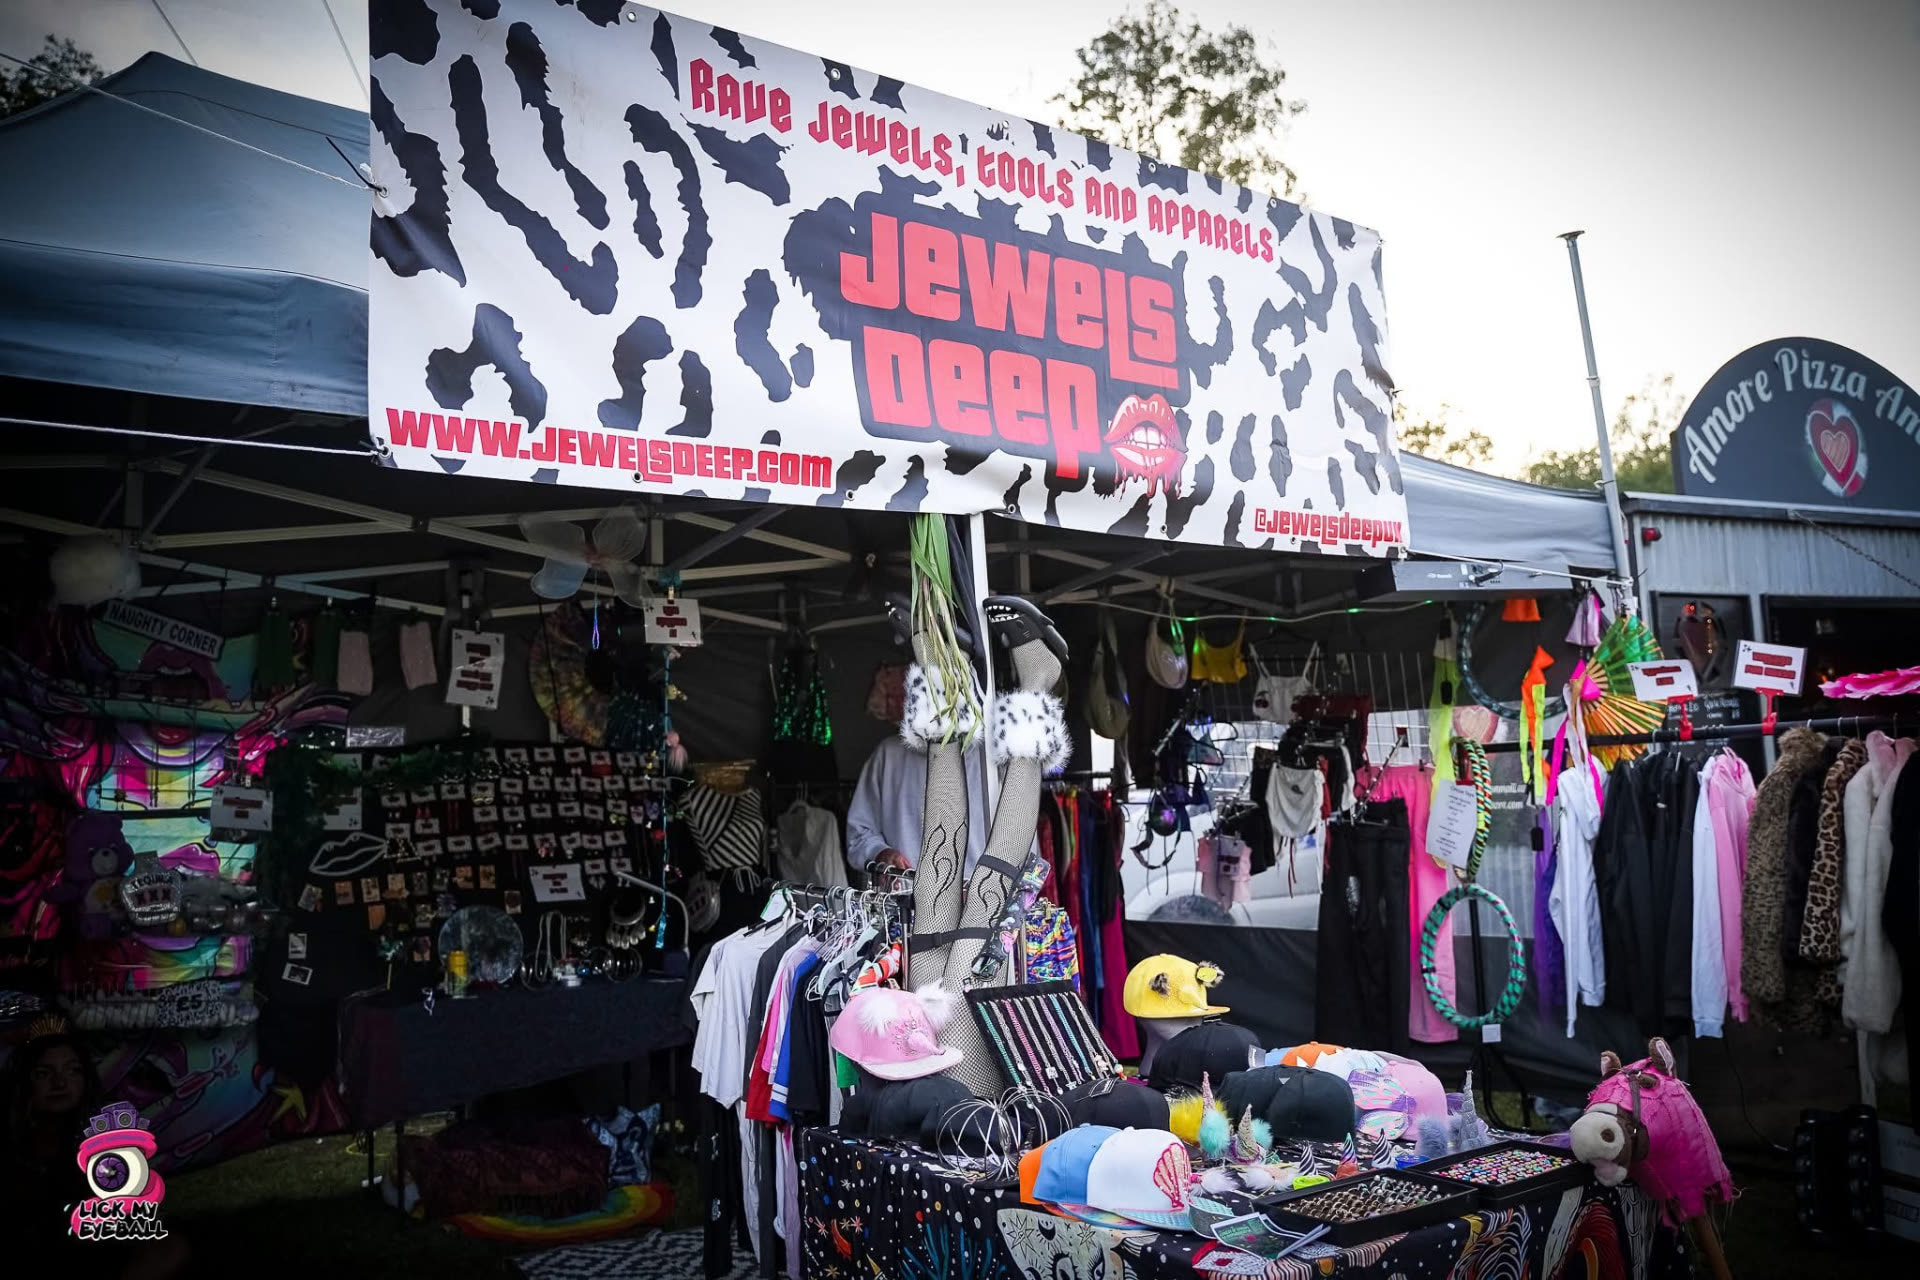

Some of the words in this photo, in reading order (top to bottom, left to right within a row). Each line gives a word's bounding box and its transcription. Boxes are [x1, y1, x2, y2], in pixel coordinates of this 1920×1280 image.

[1684, 369, 1773, 484] Amore
[1774, 347, 1868, 401] Pizza
[1875, 385, 1920, 446] Am
[108, 603, 168, 636] NAUGHTY
[169, 624, 218, 654] CORNER
